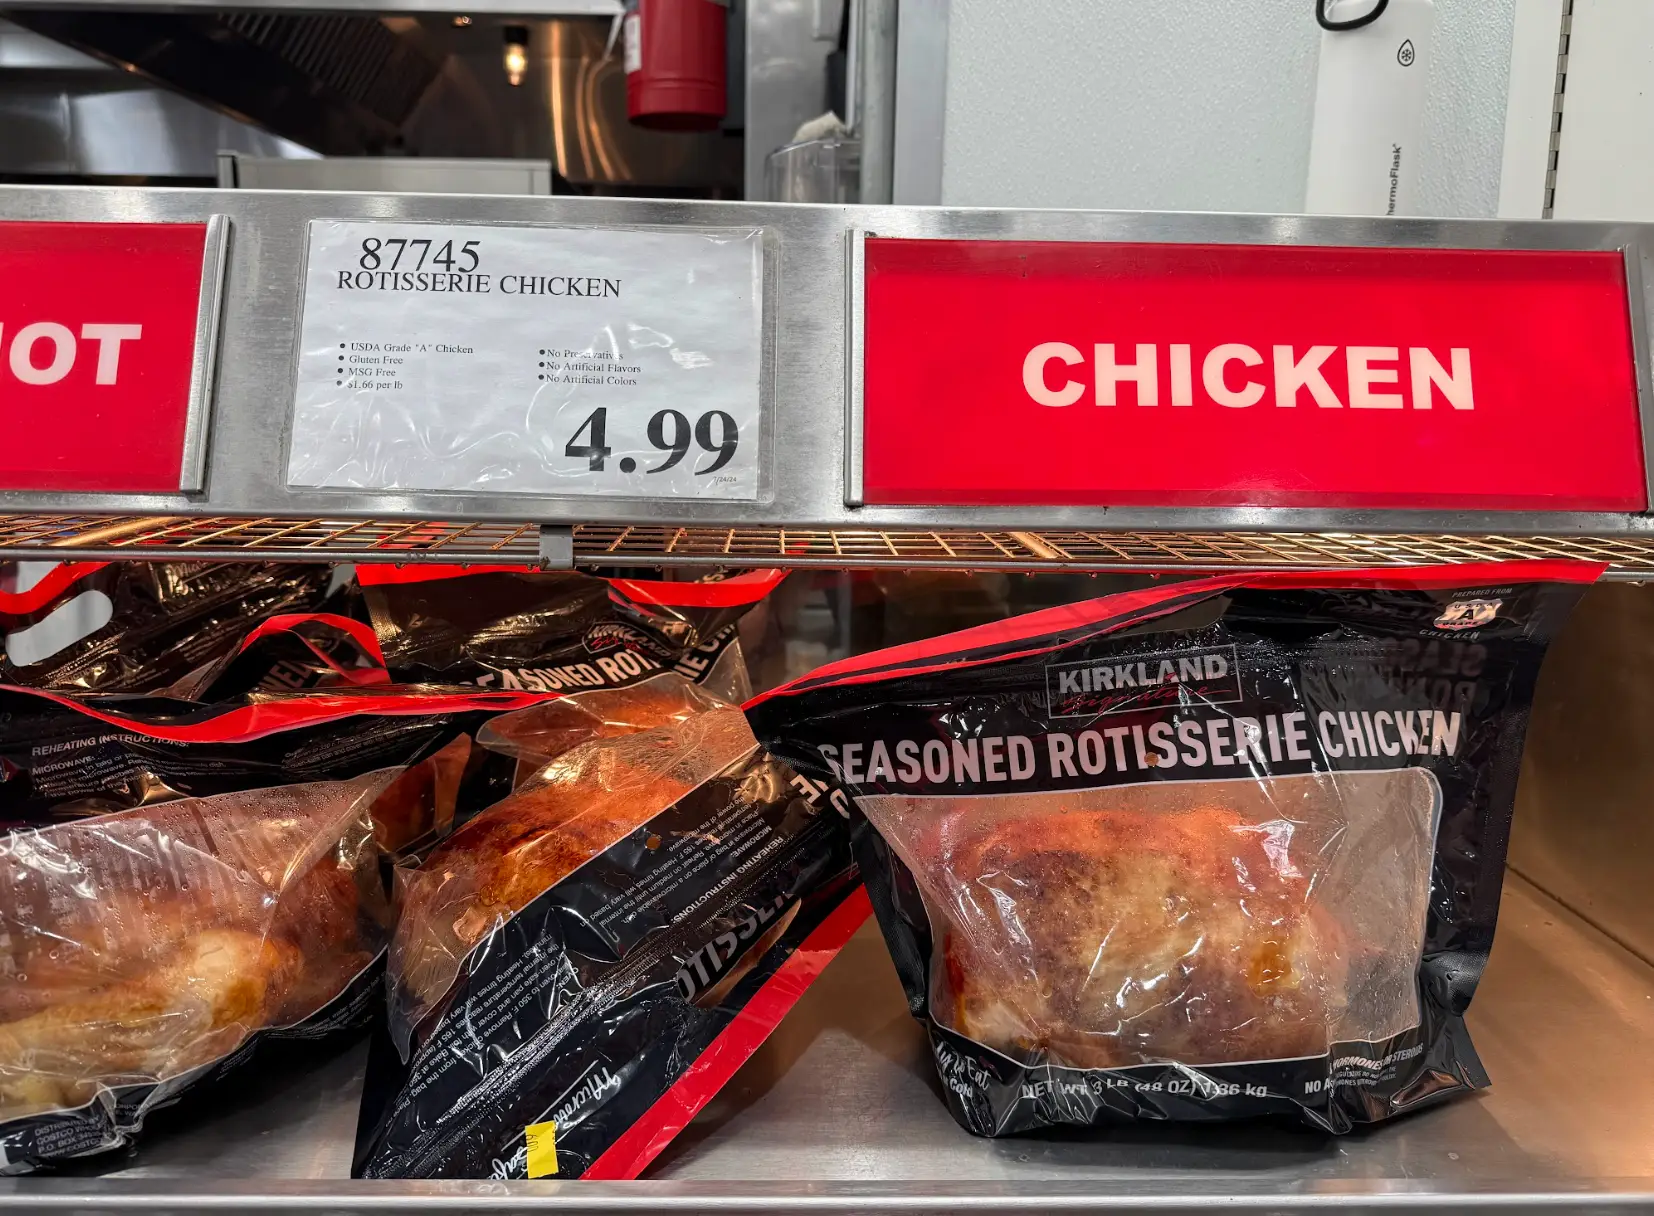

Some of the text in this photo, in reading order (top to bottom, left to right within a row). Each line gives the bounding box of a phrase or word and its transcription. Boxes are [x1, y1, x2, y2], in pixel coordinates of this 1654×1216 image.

[1386, 143, 1402, 216] hermoFlask
[359, 237, 481, 272] 87745
[337, 270, 622, 298] ROTISSERIE CHICKEN
[0, 322, 143, 386] OT
[351, 343, 474, 354] USDA Grade "A" Chicken
[546, 349, 560, 357] No
[349, 355, 404, 364] Gluten Free
[546, 362, 642, 373] No Artificial Flavors
[348, 368, 396, 376] MSG Free
[546, 374, 637, 386] No Artificial Colors
[1022, 342, 1475, 410] CHICKEN
[348, 380, 403, 390] $1.66 per lb
[564, 406, 740, 476] 4.99
[1452, 588, 1490, 598] PREPARED
[1457, 609, 1474, 620] A
[1418, 629, 1480, 640] CHICKEN
[1058, 654, 1228, 694] KIRKLAND
[32, 737, 96, 761] REHEATING
[816, 710, 1461, 785] SEASONED ROTISSERIE CHICKEN
[32, 755, 95, 776] MICROWAVE:
[715, 801, 735, 818] power
[740, 809, 758, 825] Place
[699, 820, 711, 831] the
[709, 815, 718, 824] of
[733, 816, 764, 843] Microwave
[702, 825, 735, 852] microave.
[730, 824, 772, 859] MICROWAVE:
[676, 852, 684, 860] F.
[682, 843, 695, 855] 165
[714, 843, 728, 856] bag
[651, 856, 678, 877] Heating
[681, 849, 704, 869] Reheat
[691, 857, 710, 874] place
[672, 865, 682, 874] on
[682, 870, 692, 880] on
[634, 872, 654, 889] times
[646, 871, 673, 892] medium
[669, 835, 783, 924] REHEATING INSTRUCTIONS:
[609, 891, 625, 906] vary
[623, 884, 637, 897] will
[633, 888, 649, 902] until
[635, 880, 679, 914] microwavable
[588, 902, 611, 922] based
[622, 898, 636, 911] the
[598, 906, 624, 928] internal
[546, 942, 559, 955] the
[494, 957, 524, 983] Heating
[523, 958, 556, 987] oven-safe
[476, 979, 497, 998] times
[482, 971, 524, 1008] temperature
[508, 983, 524, 998] pan
[530, 985, 540, 995] to
[496, 997, 512, 1012] and
[516, 992, 532, 1007] 350
[447, 1004, 465, 1020] vary
[476, 1008, 498, 1027] cover
[510, 1005, 519, 1013] F.
[482, 1011, 513, 1037] Remove
[440, 1027, 456, 1042] 165
[420, 1064, 431, 1075] at
[437, 1056, 457, 1074] from
[964, 1056, 992, 1090] Eat
[424, 1071, 440, 1085] the
[407, 1080, 427, 1098] bag.
[950, 1078, 972, 1098] Cold
[1022, 1080, 1054, 1098] NET
[1060, 1082, 1088, 1096] WT
[1092, 1082, 1102, 1096] 3
[1106, 1078, 1128, 1088] LB
[1134, 1082, 1163, 1094] (48
[1168, 1079, 1196, 1096] OZ)
[1245, 1082, 1268, 1098] kg
[1304, 1080, 1321, 1094] NO
[36, 1129, 74, 1146] COSTCO
[58, 1136, 76, 1147] BOX
